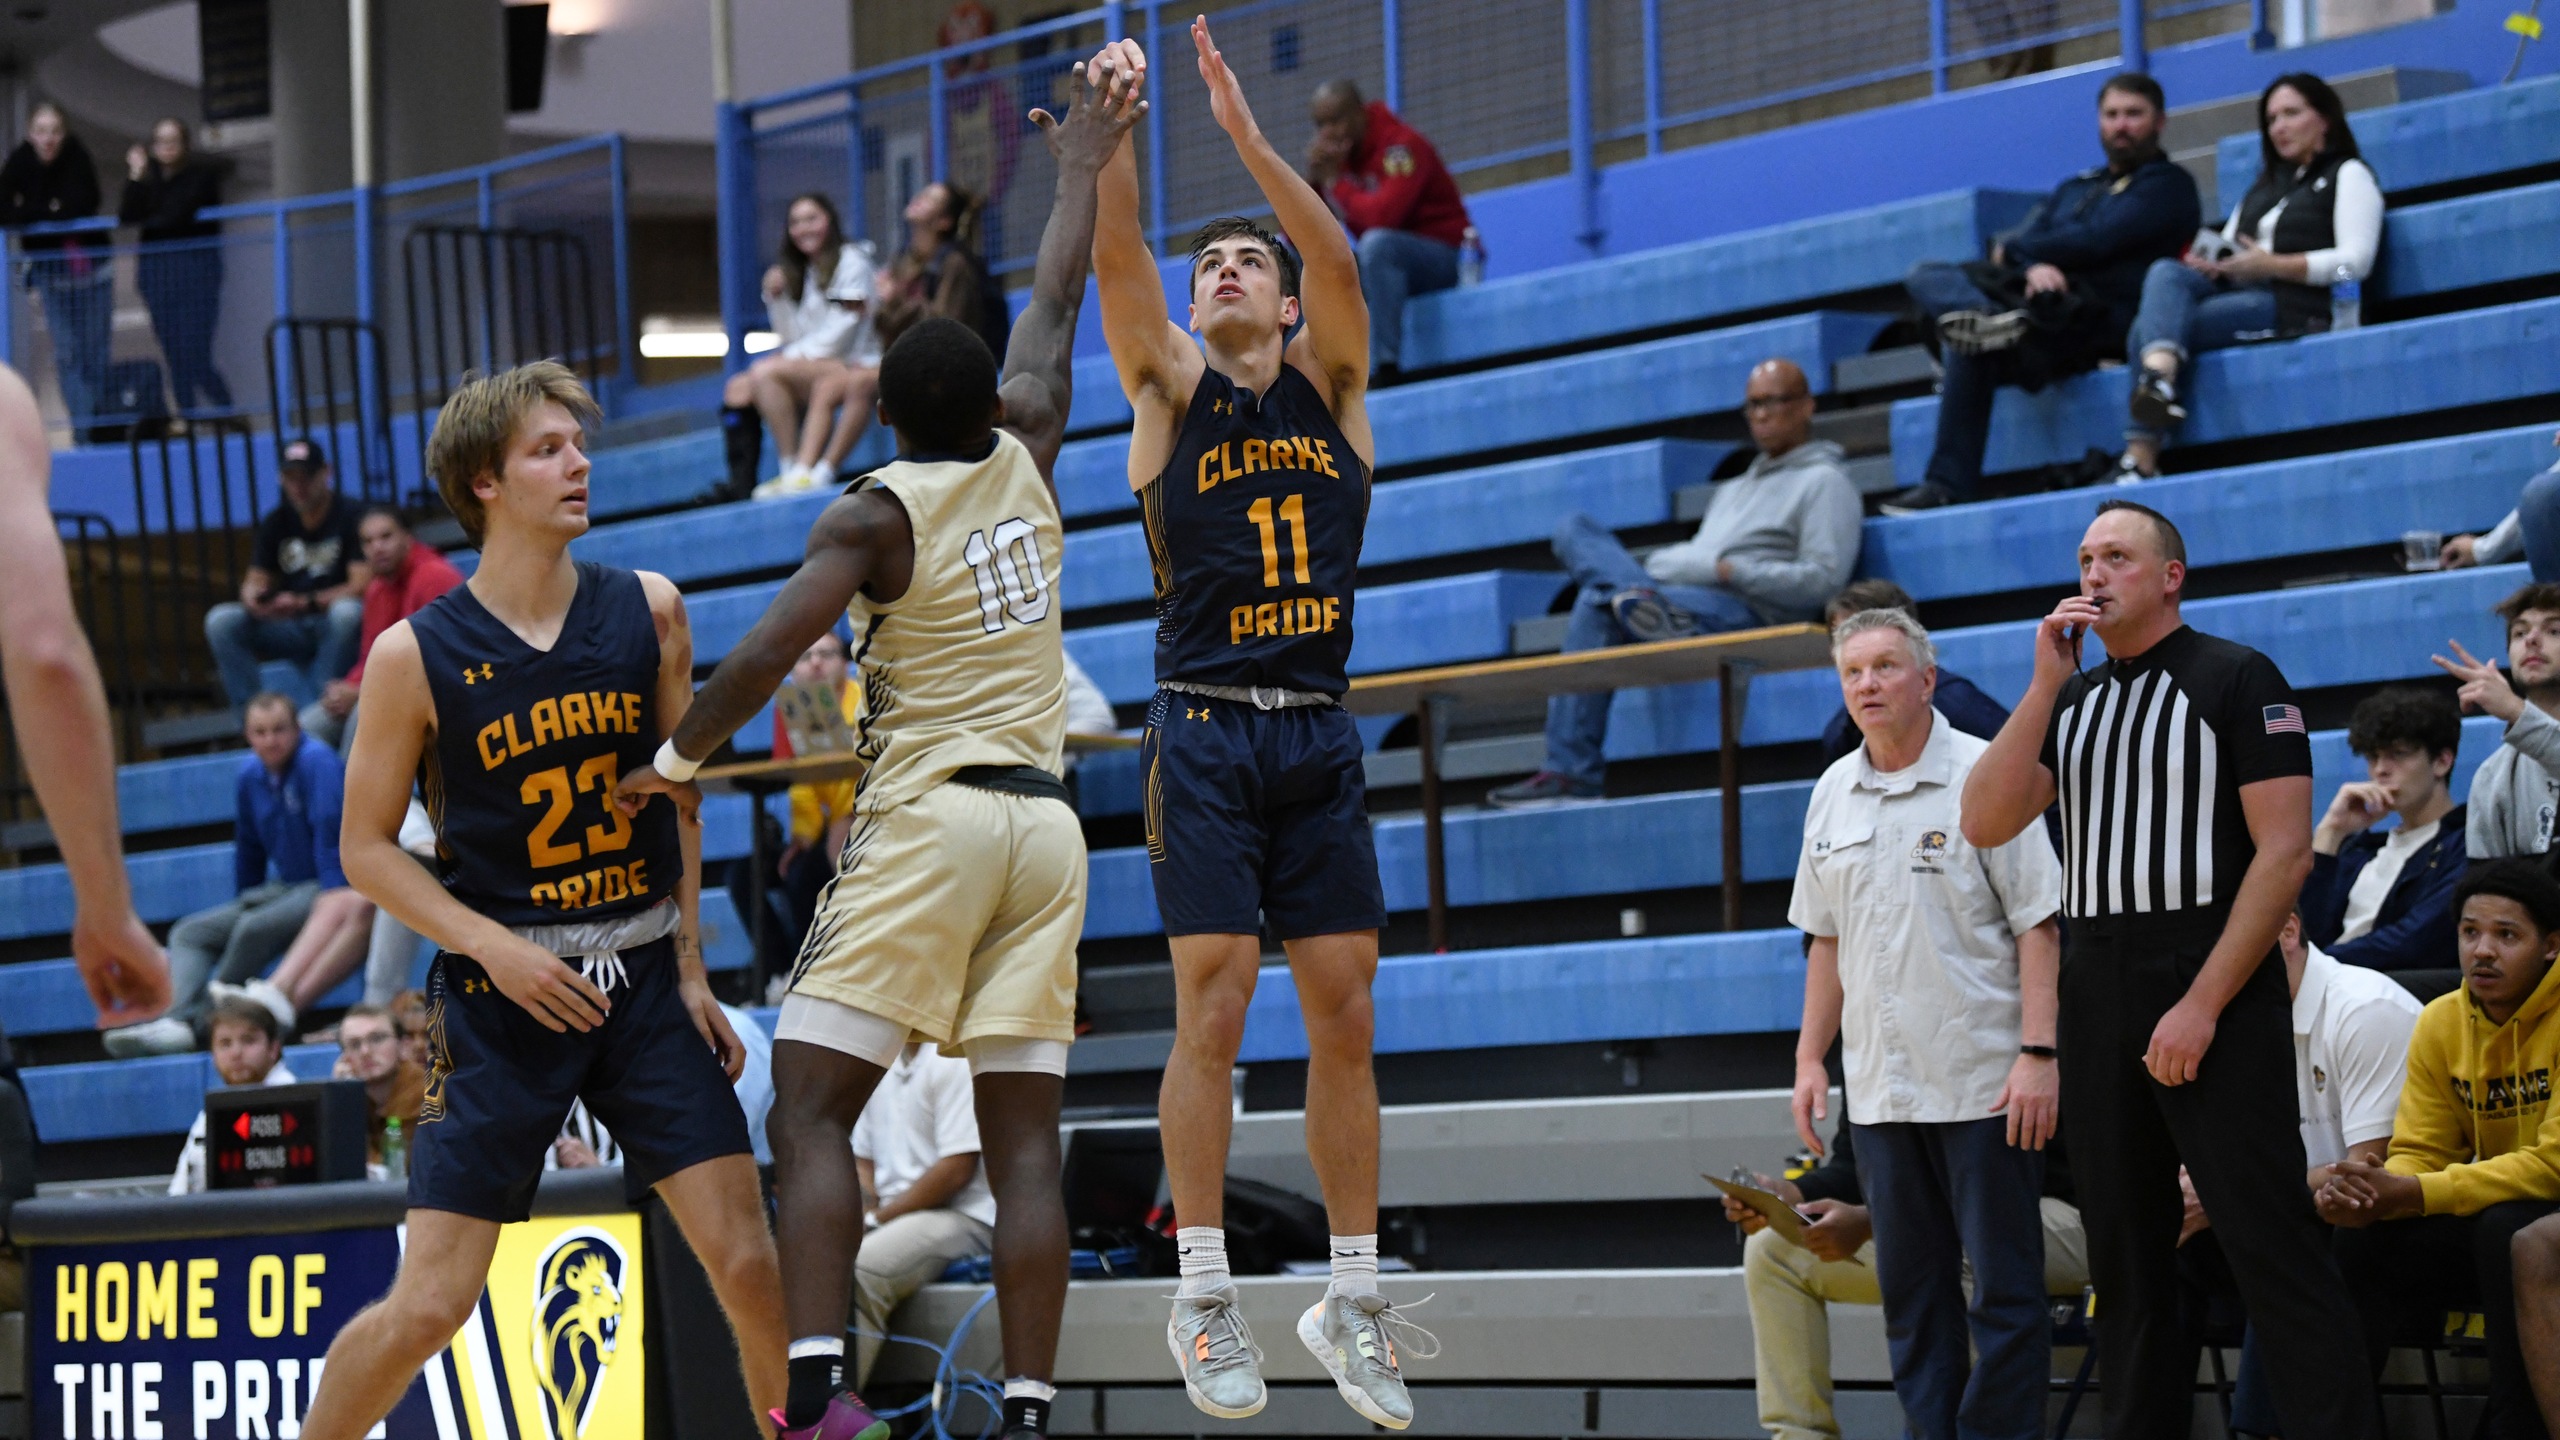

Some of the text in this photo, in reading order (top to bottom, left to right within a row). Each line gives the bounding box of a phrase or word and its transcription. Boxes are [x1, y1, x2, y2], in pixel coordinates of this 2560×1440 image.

[1198, 436, 1340, 494] CLARKE
[963, 516, 1050, 634] 10
[1247, 494, 1311, 587] 11
[1230, 597, 1340, 645] PRIDE
[476, 692, 641, 771] CLARKE
[520, 751, 632, 868] 23
[56, 1253, 326, 1343] HOME OF
[53, 1358, 386, 1440] THE PRI
